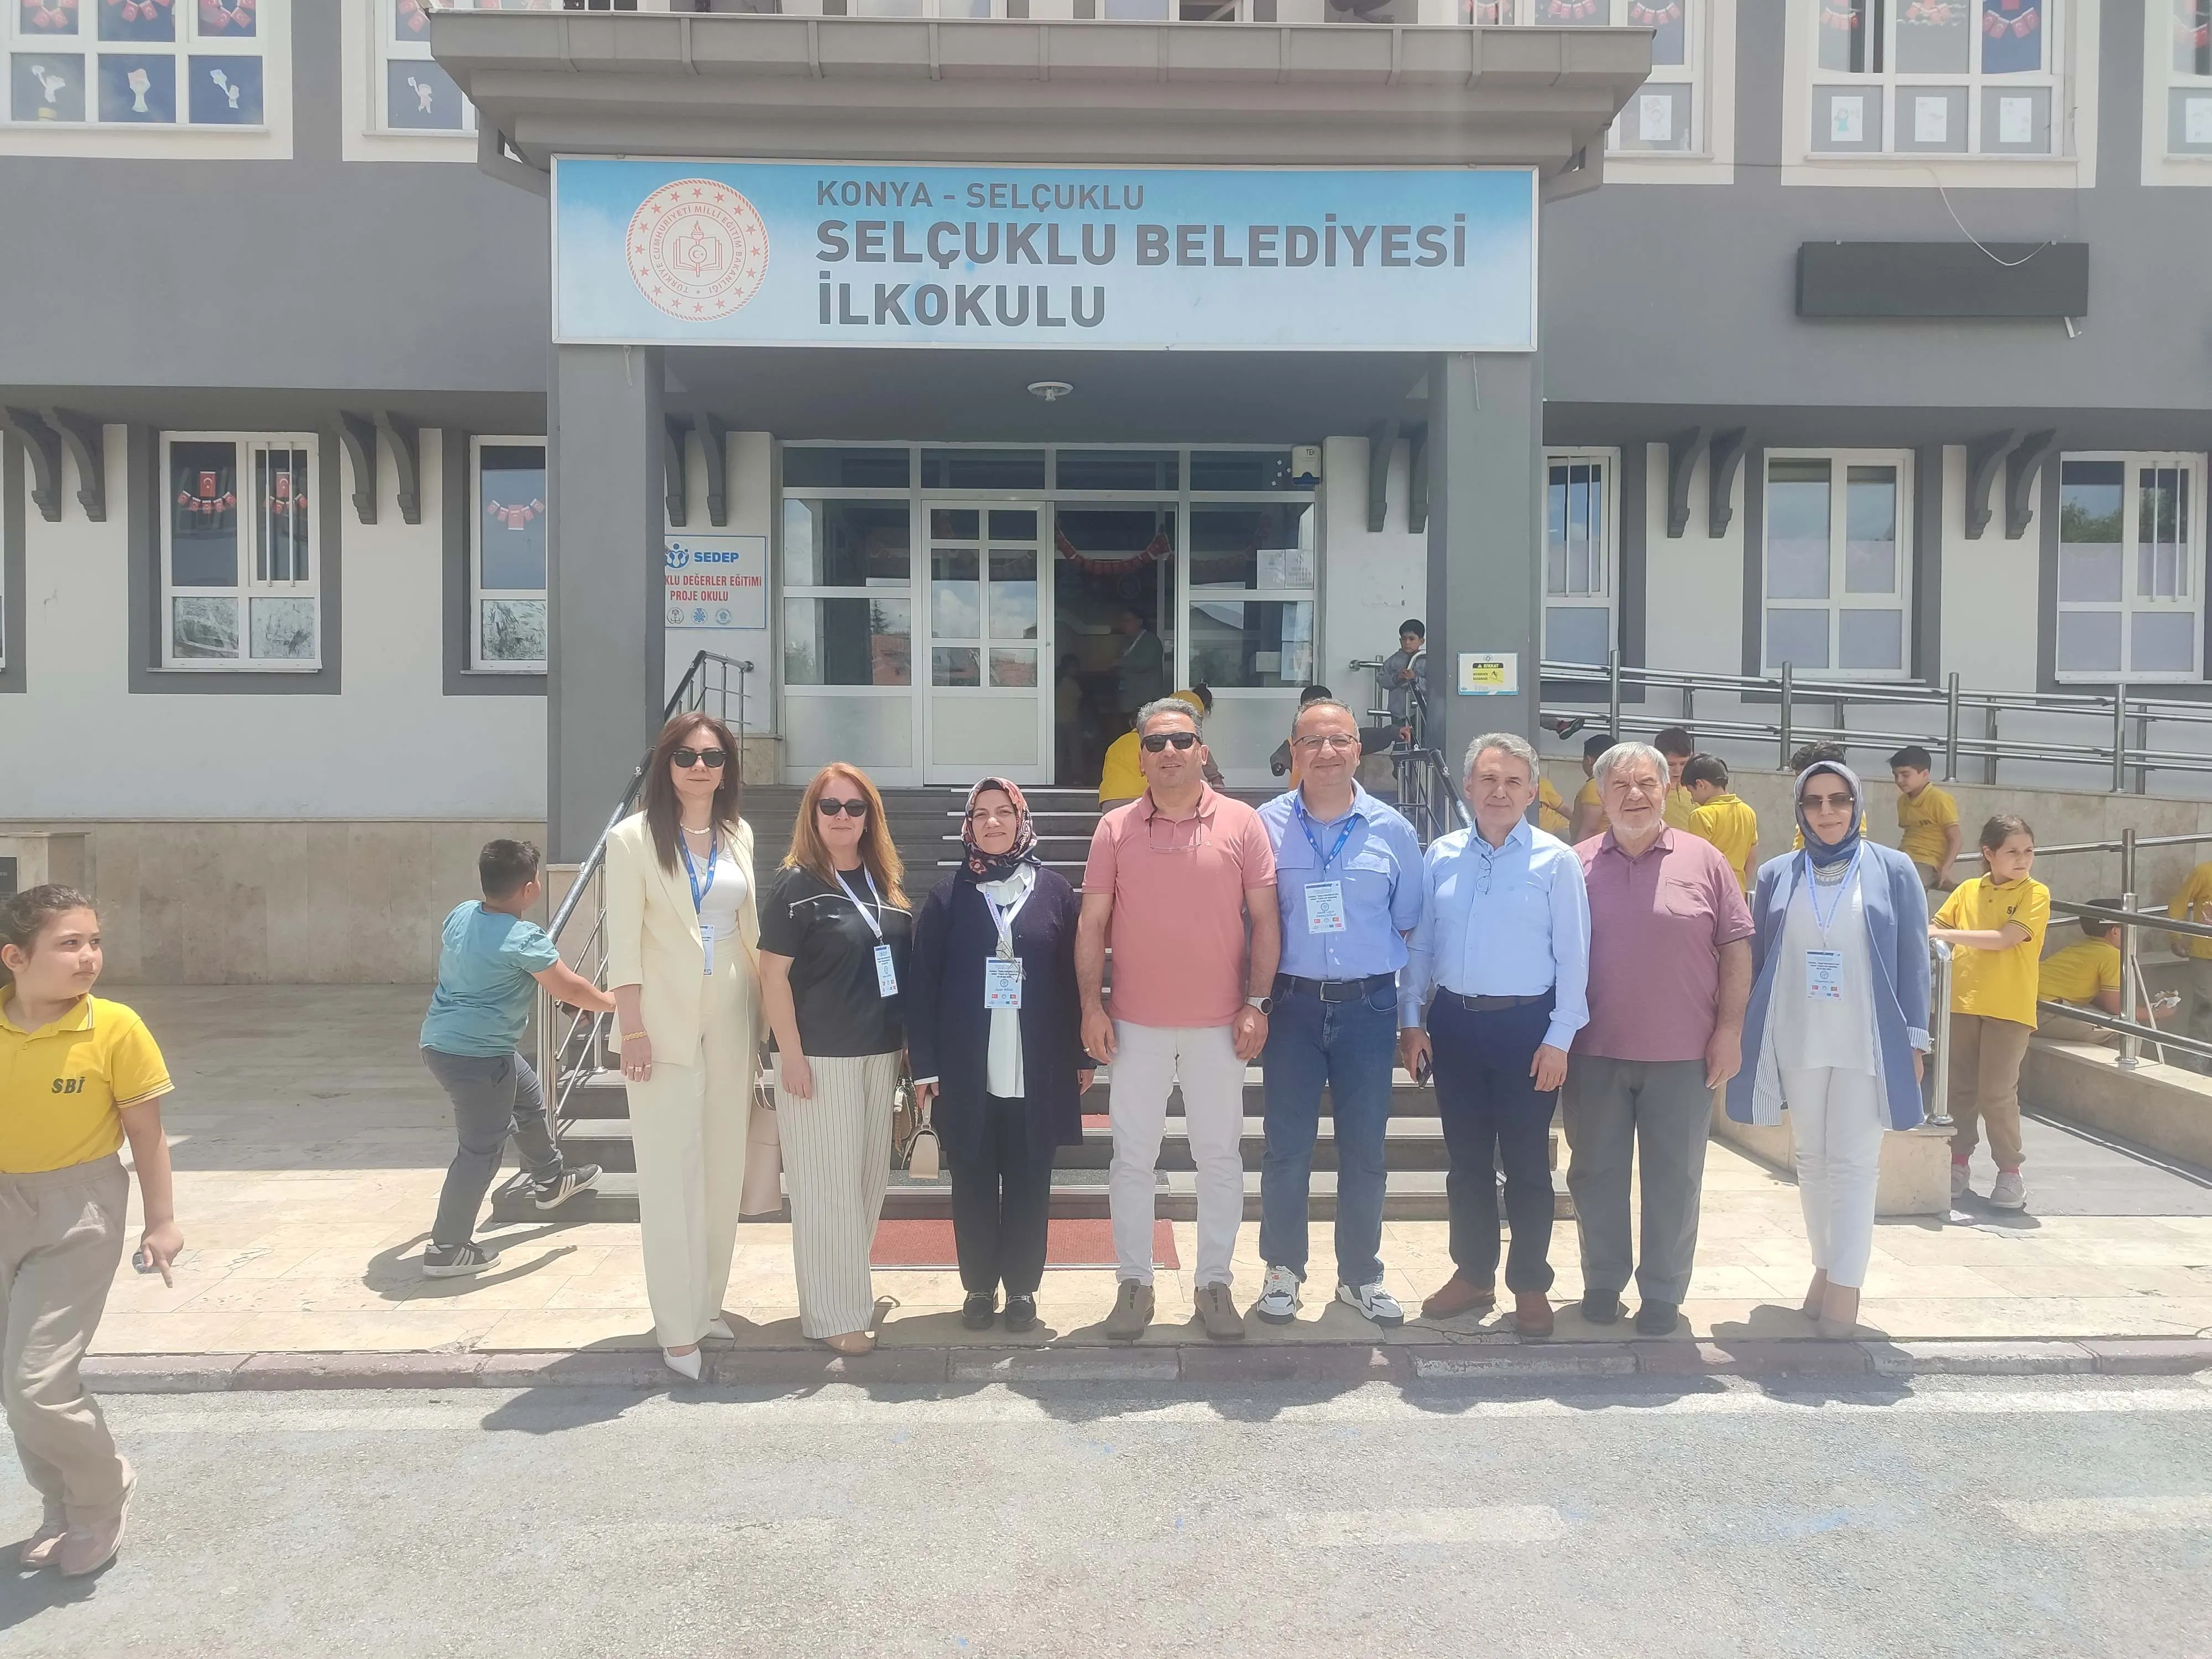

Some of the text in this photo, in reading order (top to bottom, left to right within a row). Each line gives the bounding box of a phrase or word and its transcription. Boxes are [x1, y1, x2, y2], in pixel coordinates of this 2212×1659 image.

[817, 180, 933, 207] KONYA
[966, 182, 1144, 213] SELÇUKLU
[815, 213, 1465, 270] SELÇUKLU BELEDİYESİ
[819, 270, 1105, 327] İLKOKULU
[694, 551, 739, 563] SEDEP
[683, 573, 727, 586] DEĞERLER
[730, 573, 762, 587] EĞİTİMİ
[670, 590, 729, 602] PROJE OKULU
